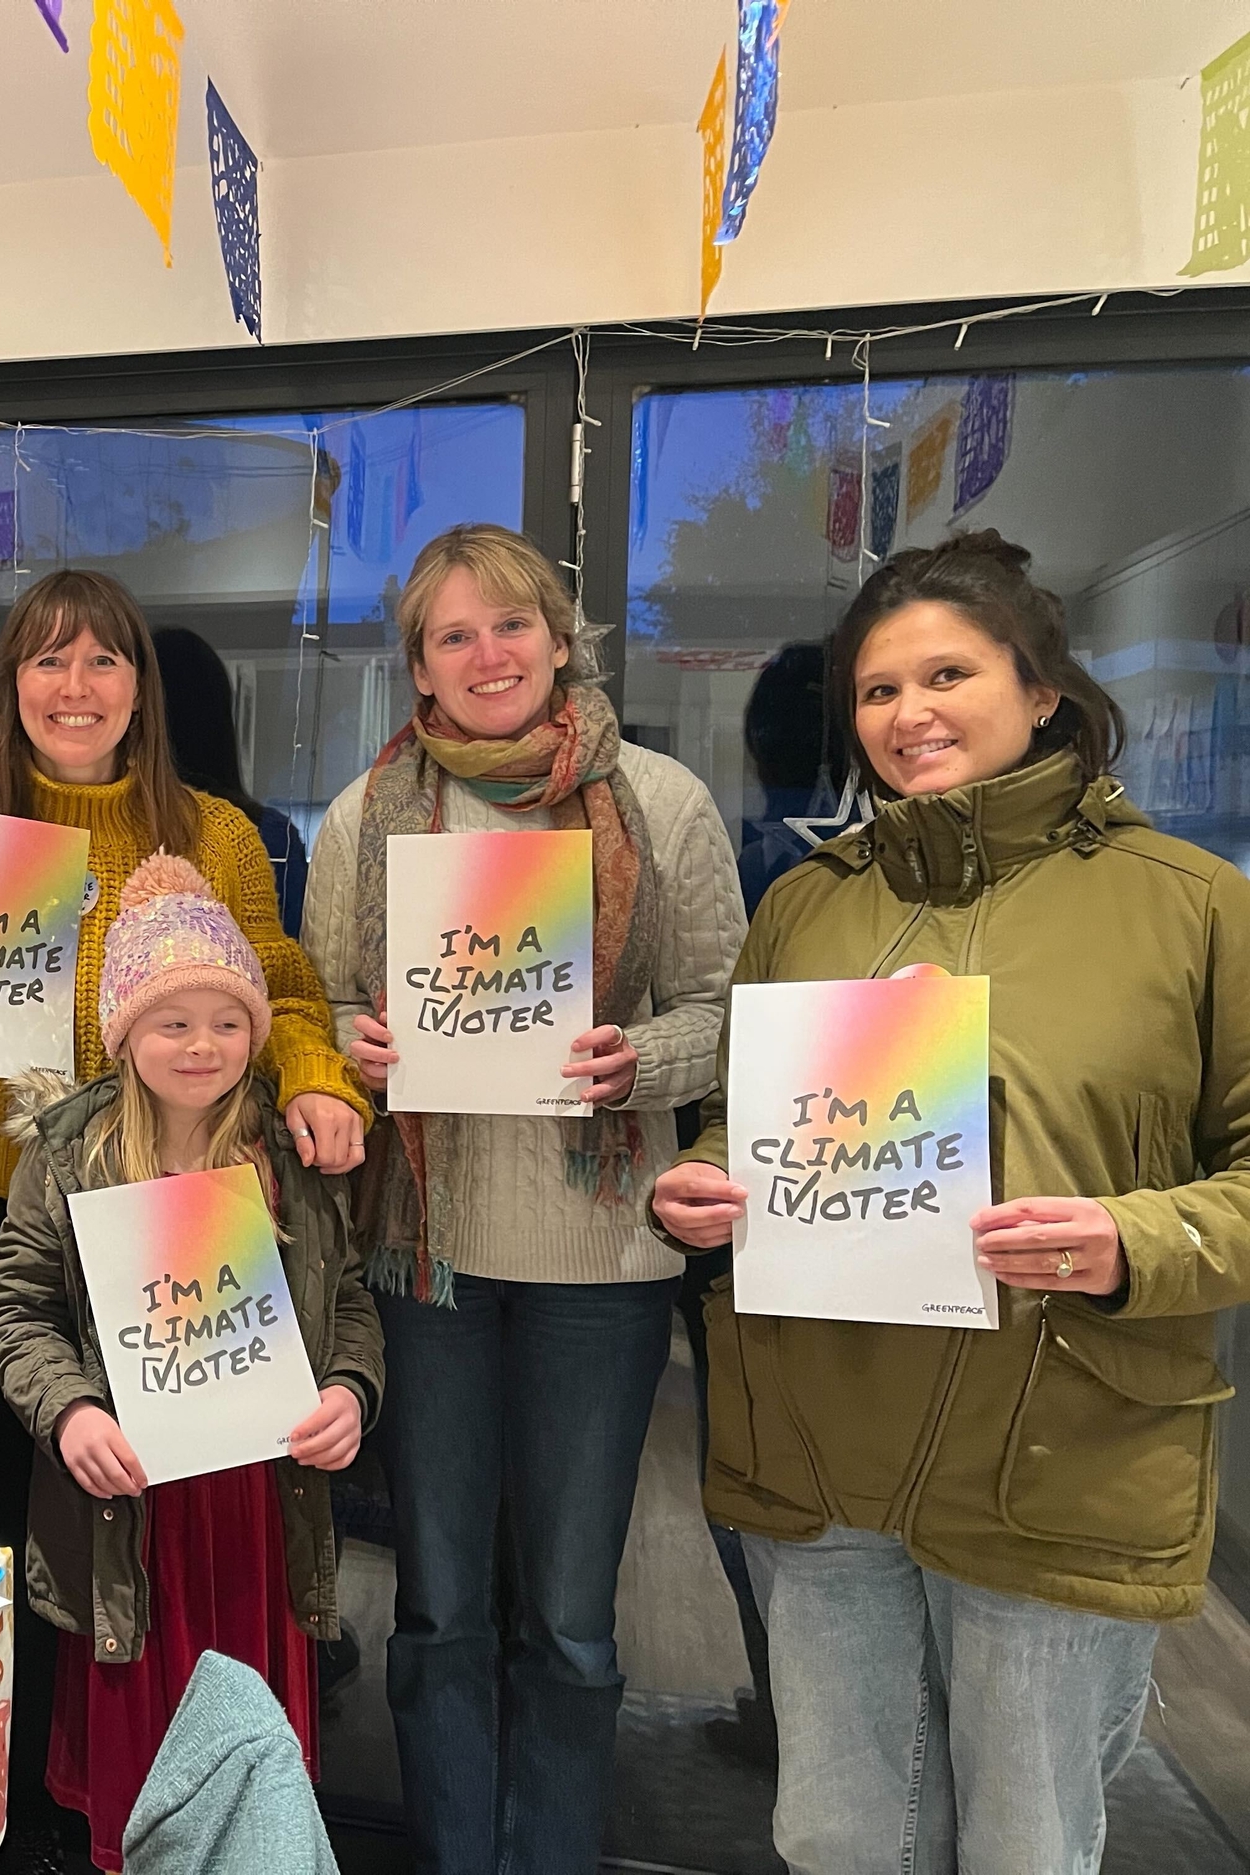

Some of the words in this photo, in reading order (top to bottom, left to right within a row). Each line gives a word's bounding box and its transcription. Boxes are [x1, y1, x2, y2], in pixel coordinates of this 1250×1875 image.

[20, 909, 41, 935] A
[440, 925, 500, 959] I'M
[517, 926, 542, 953] A
[406, 960, 573, 996] CLIMATE
[792, 1087, 868, 1127] I'M
[889, 1089, 922, 1122] A
[751, 1131, 964, 1174] CLIMATE
[142, 1273, 202, 1313] I'M
[217, 1264, 241, 1293] A
[118, 1293, 278, 1350] CLIMATE
[922, 1303, 985, 1315] GREENPEACE
